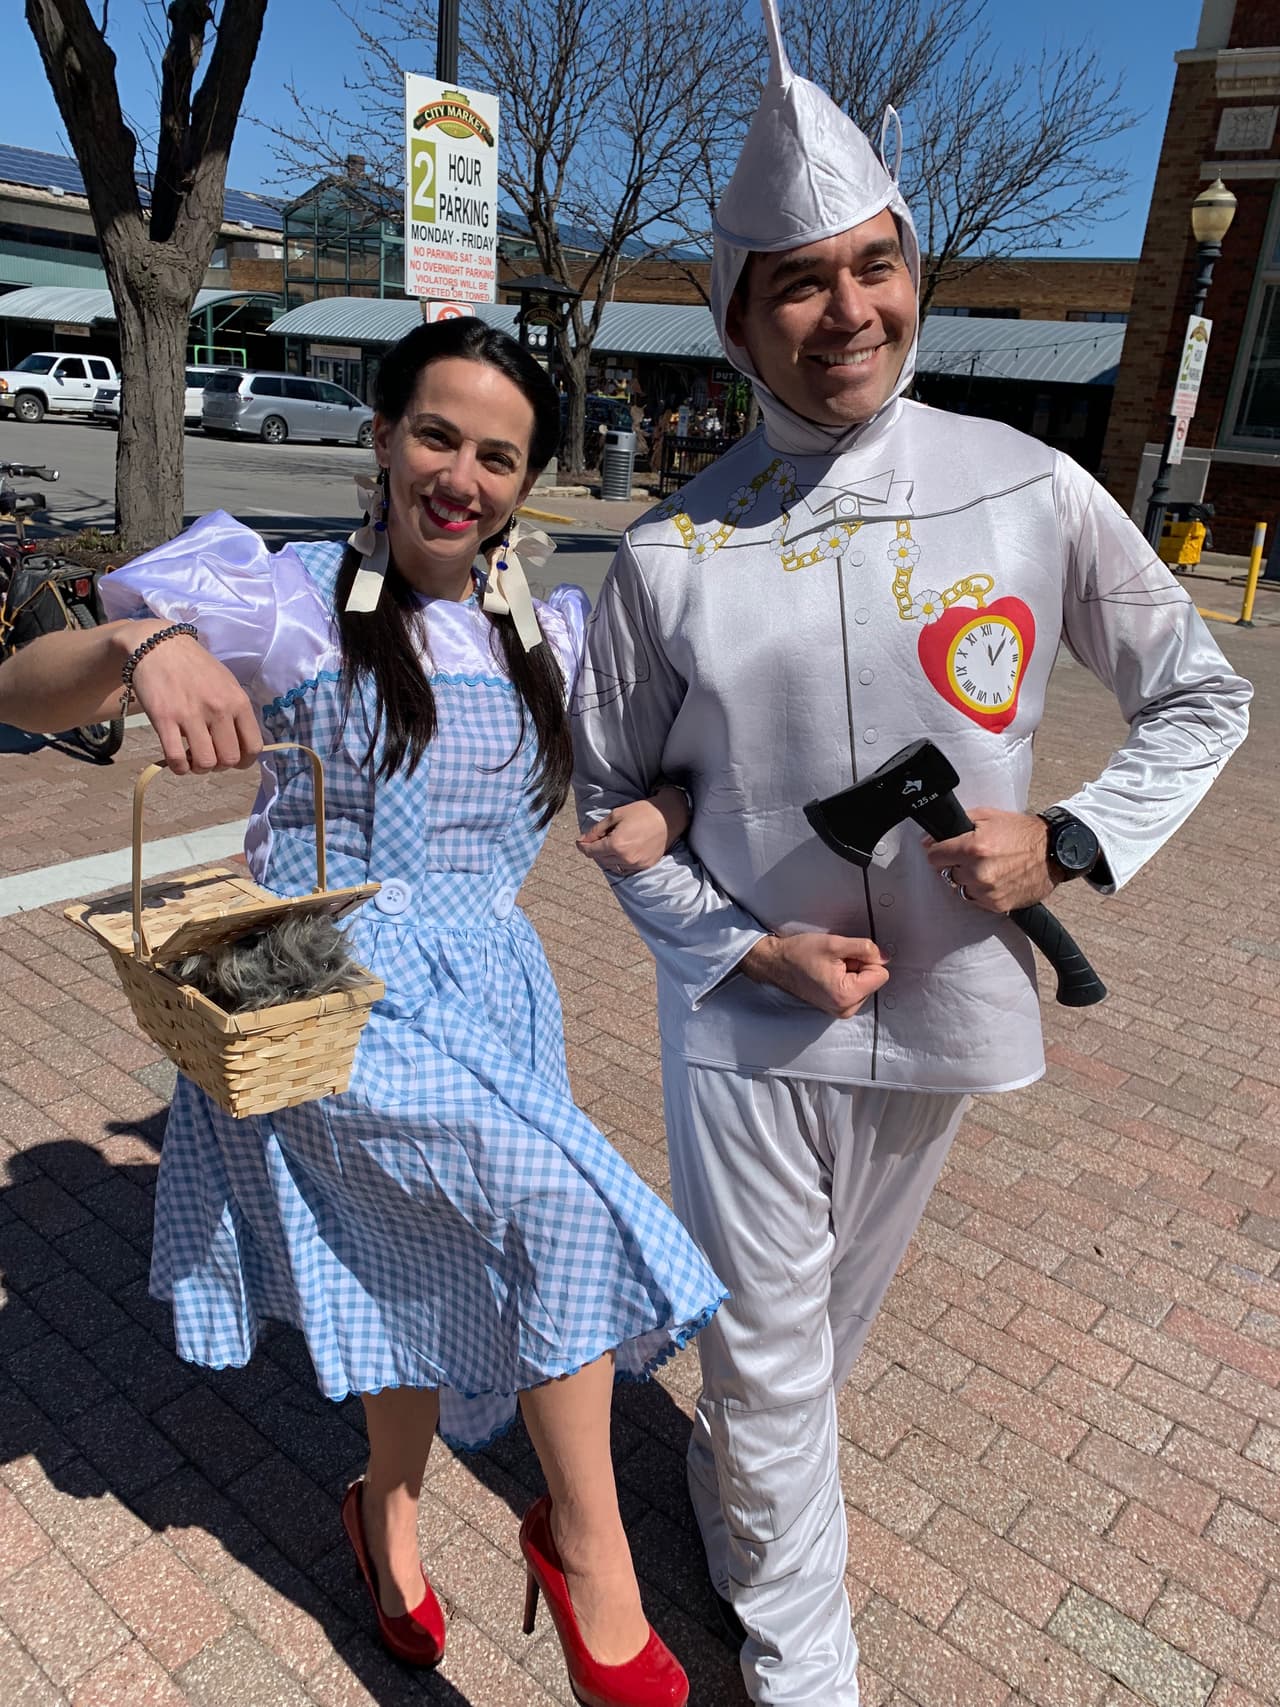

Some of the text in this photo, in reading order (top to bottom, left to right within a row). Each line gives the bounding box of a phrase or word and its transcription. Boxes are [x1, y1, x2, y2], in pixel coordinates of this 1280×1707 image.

[424, 106, 445, 120] CITY
[448, 105, 486, 133] MARKET
[449, 153, 482, 187] HOUR
[414, 151, 434, 208] 2
[439, 193, 489, 228] PARKING
[411, 224, 454, 245] MONDAY
[462, 232, 495, 251] FRIDAY
[413, 246, 425, 257] NO
[426, 248, 458, 262] PARKING
[459, 252, 473, 263] SAT
[478, 255, 492, 266] SUN
[410, 260, 495, 280] NO OVERNIGHT PARKING
[415, 273, 488, 291] VIOLATORS WILL BE
[413, 285, 490, 301] TICKETED OR TOWED
[965, 632, 978, 646] XI
[980, 624, 992, 637] XII
[1009, 636, 1016, 646] II
[957, 648, 968, 659] X
[956, 666, 967, 676] IX
[962, 679, 976, 696] VIII
[912, 796, 929, 808] 1.25
